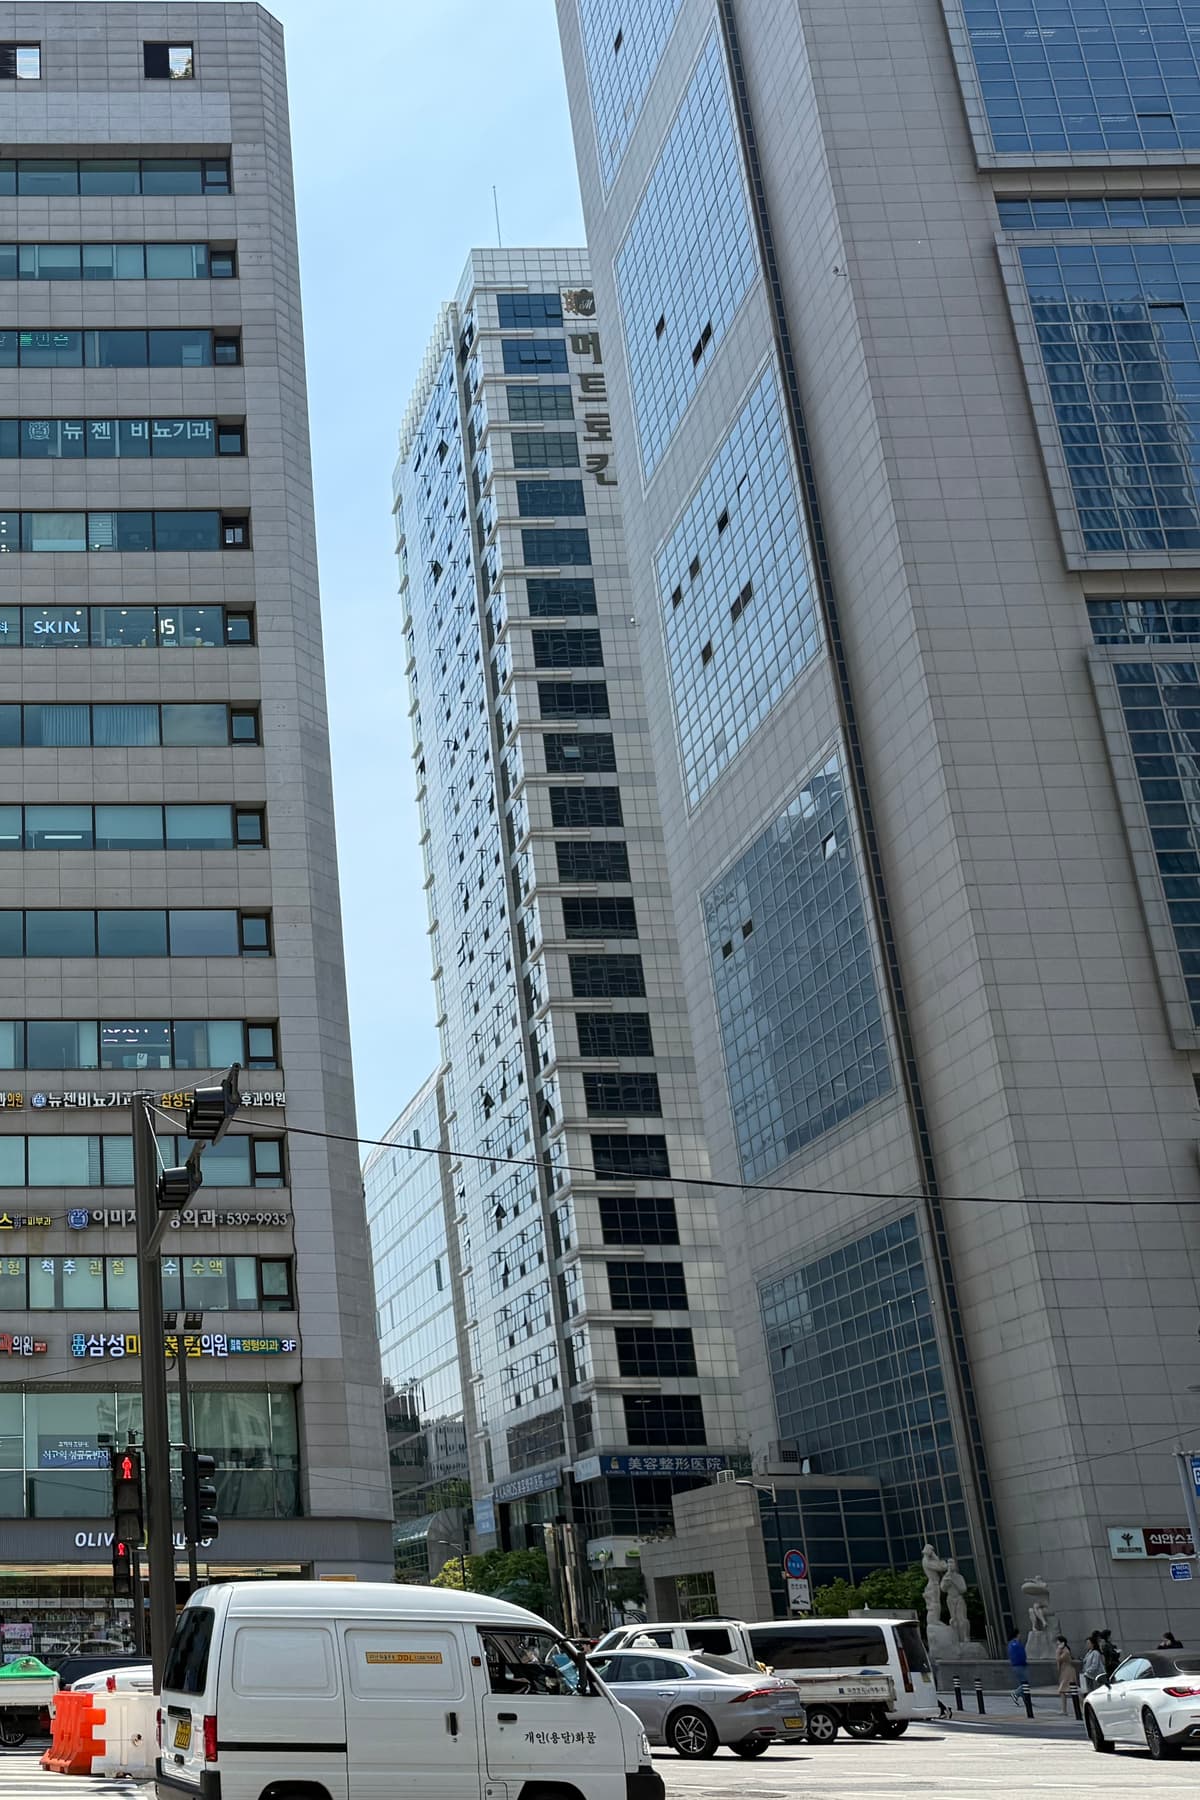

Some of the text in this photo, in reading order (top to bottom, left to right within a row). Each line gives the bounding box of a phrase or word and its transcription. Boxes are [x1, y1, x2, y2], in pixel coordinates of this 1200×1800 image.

[63, 421, 212, 440] 뉴젠 비뇨기과
[33, 621, 78, 634] SKIN
[226, 1212, 288, 1226] 539-9933
[41, 1260, 76, 1276] 척추
[89, 1260, 125, 1276] 관절
[191, 1260, 223, 1275] 수액
[242, 1339, 279, 1352] 정형외과
[281, 1339, 297, 1352] 3F
[628, 1457, 722, 1471] 美容整形医院
[75, 1532, 115, 1547] OLIV
[524, 1730, 597, 1745] 개인(용달)화물
